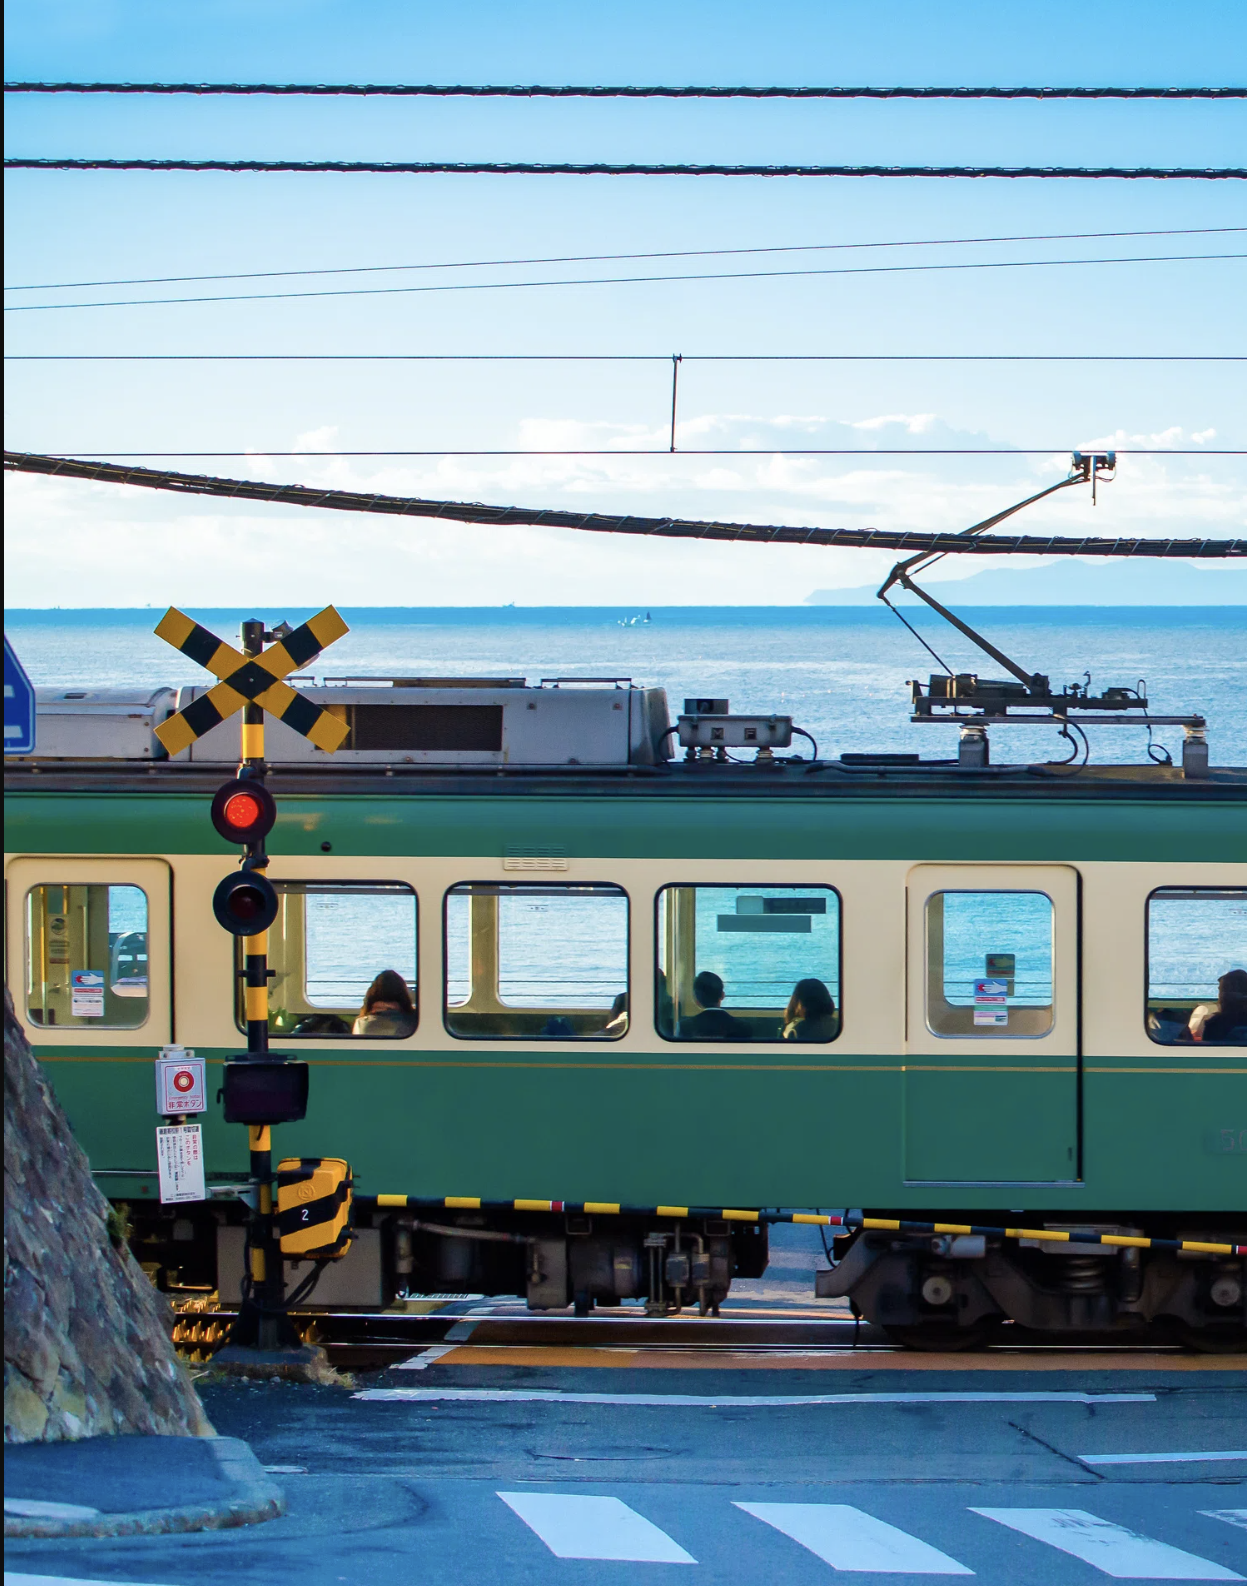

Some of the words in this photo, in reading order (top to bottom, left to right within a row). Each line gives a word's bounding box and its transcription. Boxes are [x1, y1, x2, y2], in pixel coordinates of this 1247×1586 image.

[168, 1100, 201, 1109] 非常ボタン
[301, 1209, 309, 1221] 2
